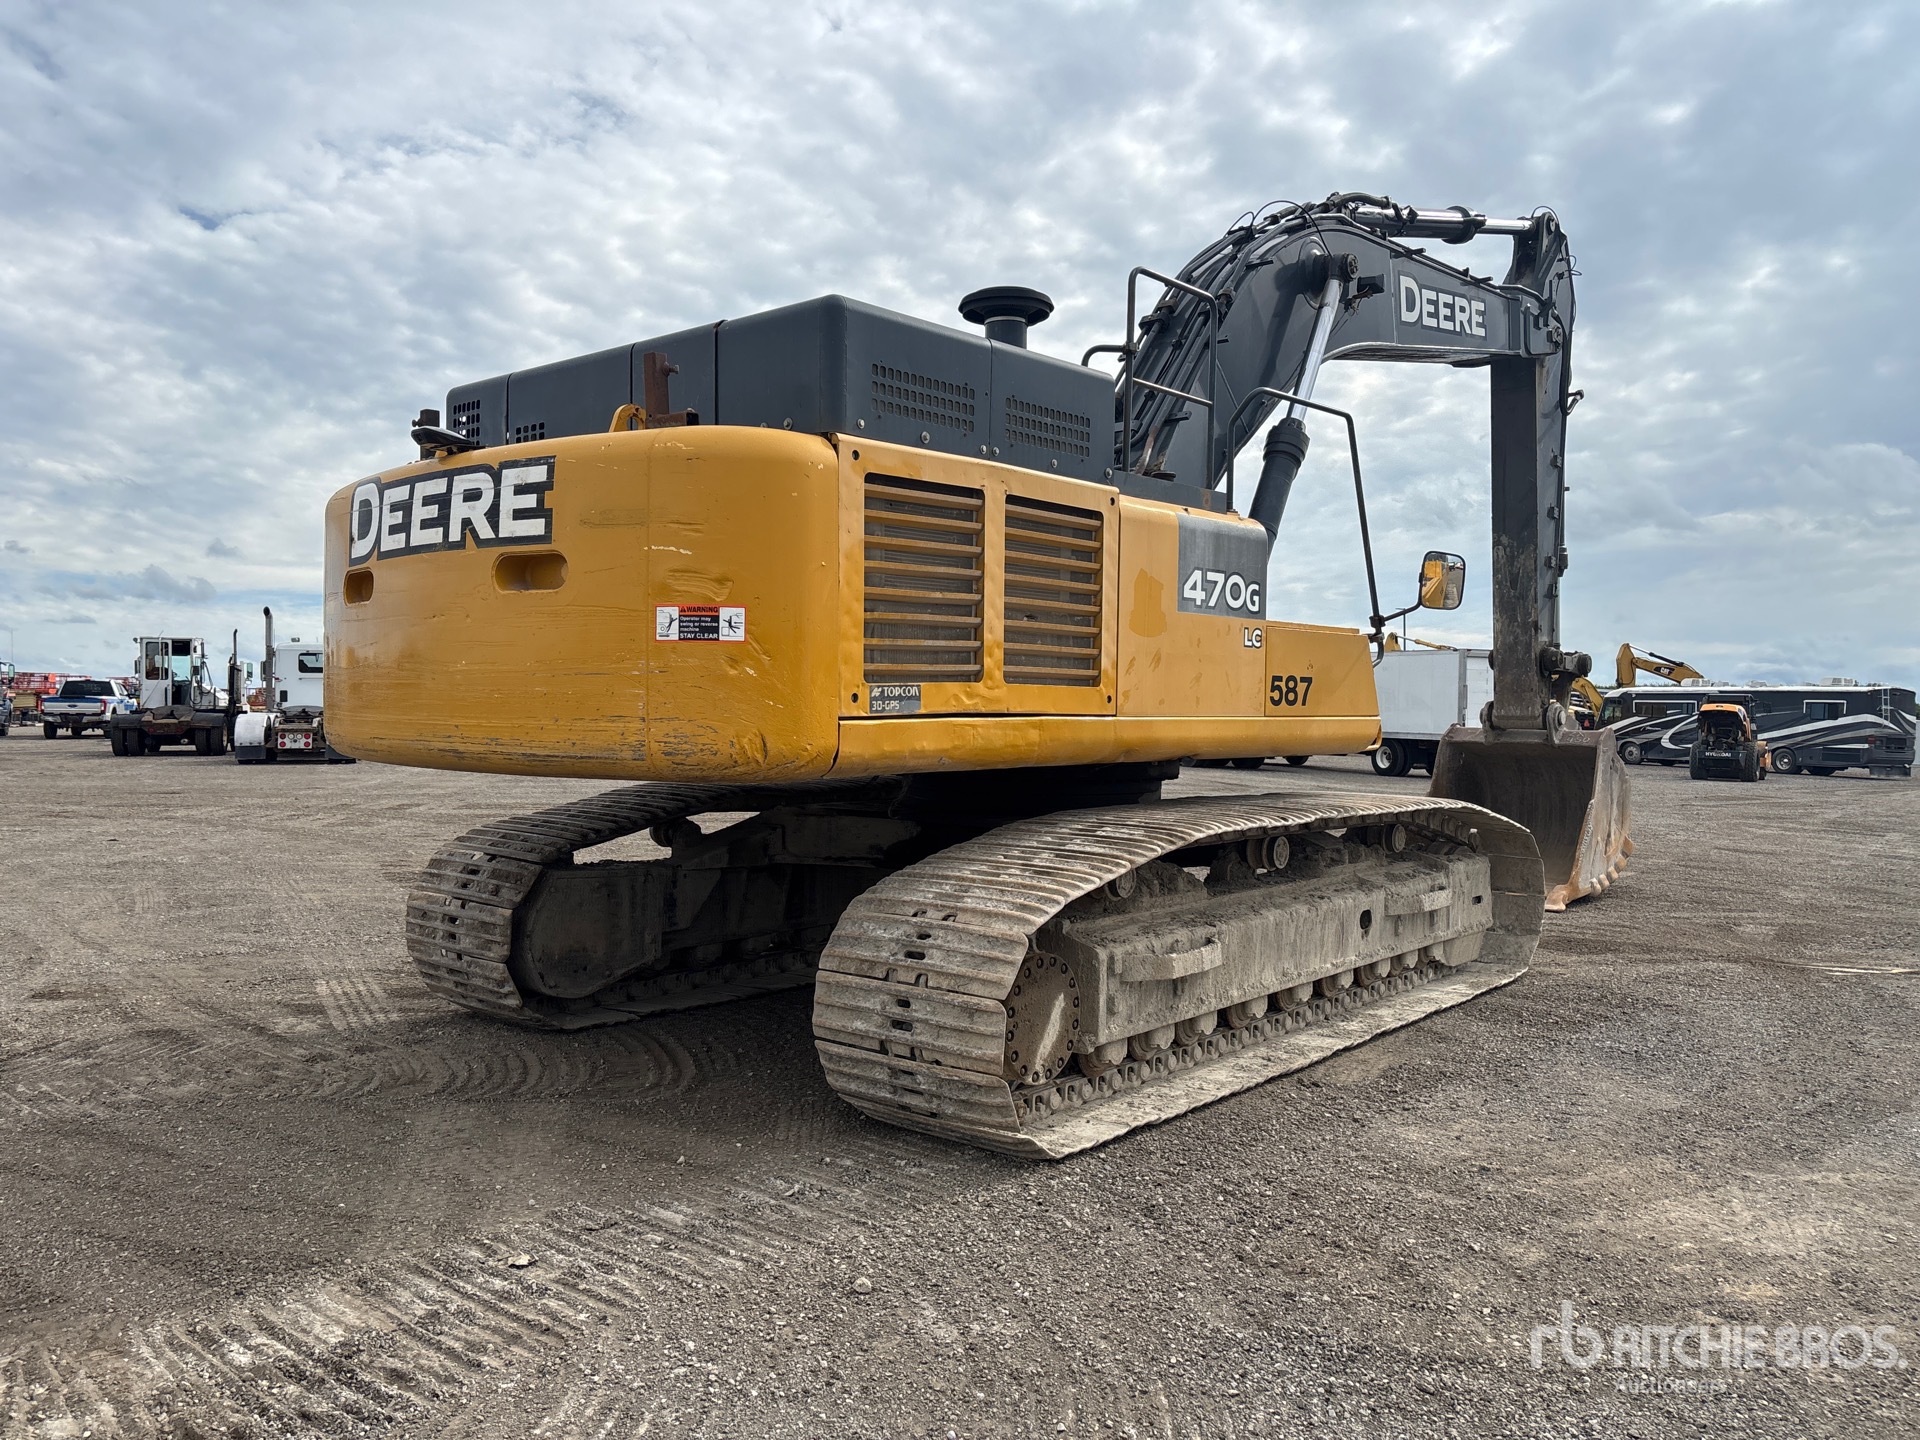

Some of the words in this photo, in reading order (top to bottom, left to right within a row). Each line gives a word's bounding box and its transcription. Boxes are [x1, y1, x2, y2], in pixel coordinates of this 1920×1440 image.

[1399, 275, 1486, 337] DEERE
[350, 464, 549, 559] DEERE
[1183, 569, 1260, 612] 470G
[1244, 628, 1262, 647] LC
[871, 700, 900, 710] 3D-GPS
[883, 686, 919, 697] TOPCON
[1269, 675, 1313, 707] 587
